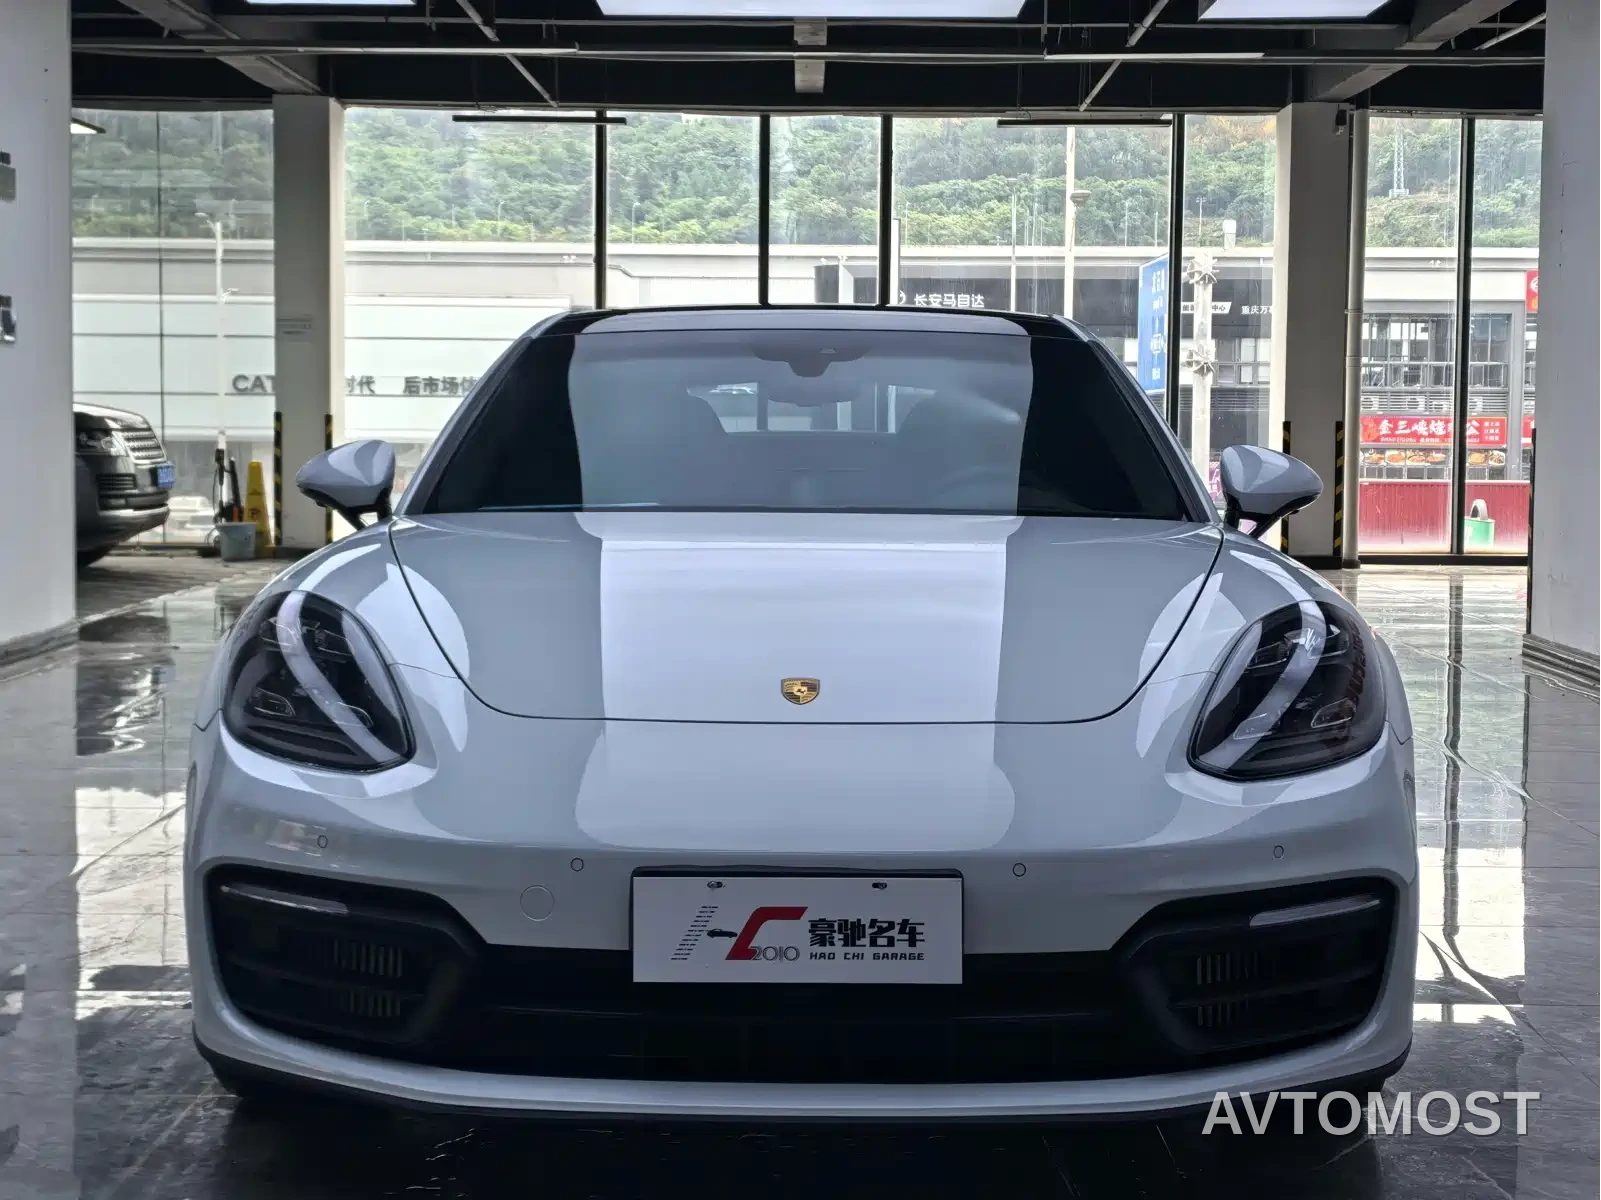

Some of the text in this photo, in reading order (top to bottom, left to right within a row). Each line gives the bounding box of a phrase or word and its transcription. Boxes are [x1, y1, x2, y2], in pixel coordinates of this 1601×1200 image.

[913, 293, 985, 308] 长安马自达
[808, 918, 925, 947] 豪驰名车
[751, 946, 800, 962] 2010
[810, 952, 925, 960] HAO CHI GARAGE
